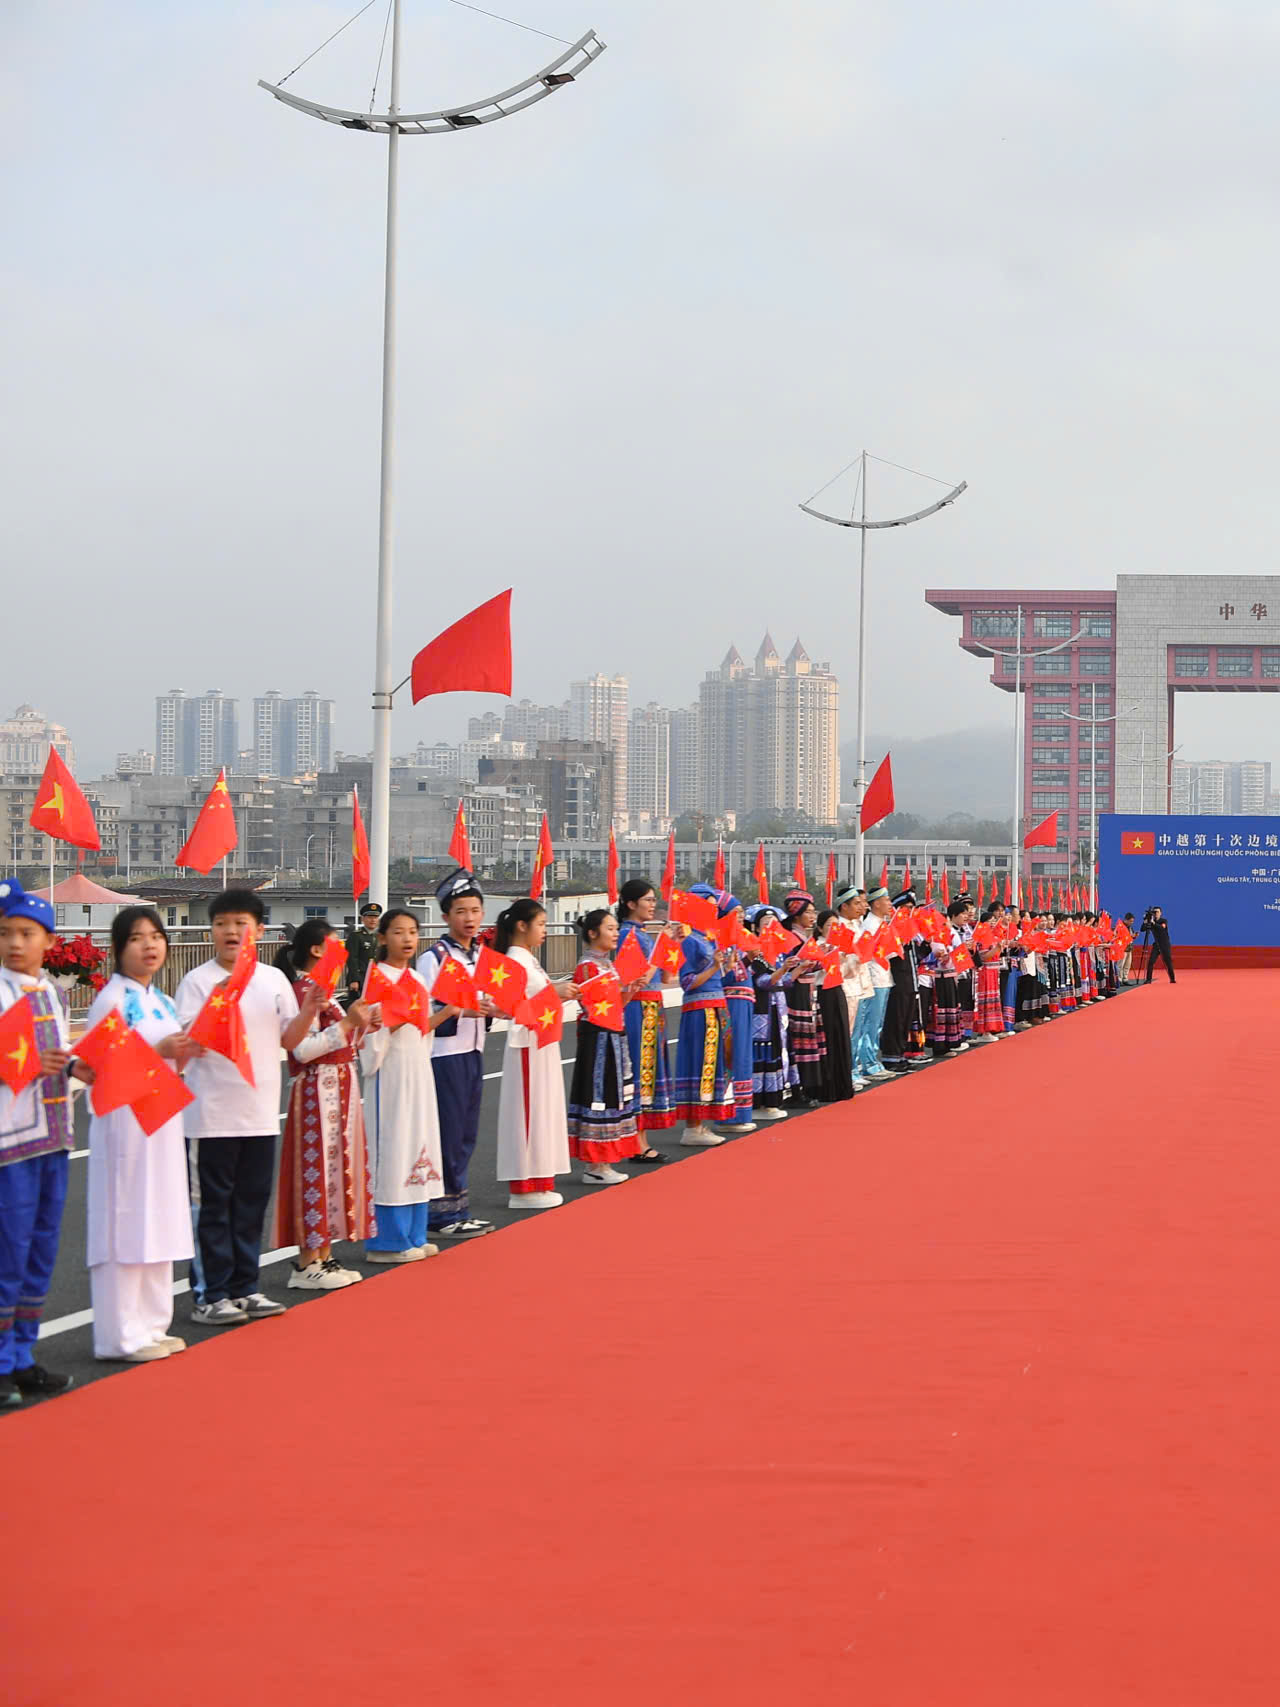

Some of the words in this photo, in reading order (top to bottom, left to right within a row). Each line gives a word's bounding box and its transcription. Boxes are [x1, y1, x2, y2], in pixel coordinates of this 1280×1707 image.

[1175, 848, 1190, 857] LƯU
[1206, 849, 1224, 859] NGHỊ
[1224, 848, 1244, 857] QUỐC
[1244, 849, 1269, 857] PHÒNG
